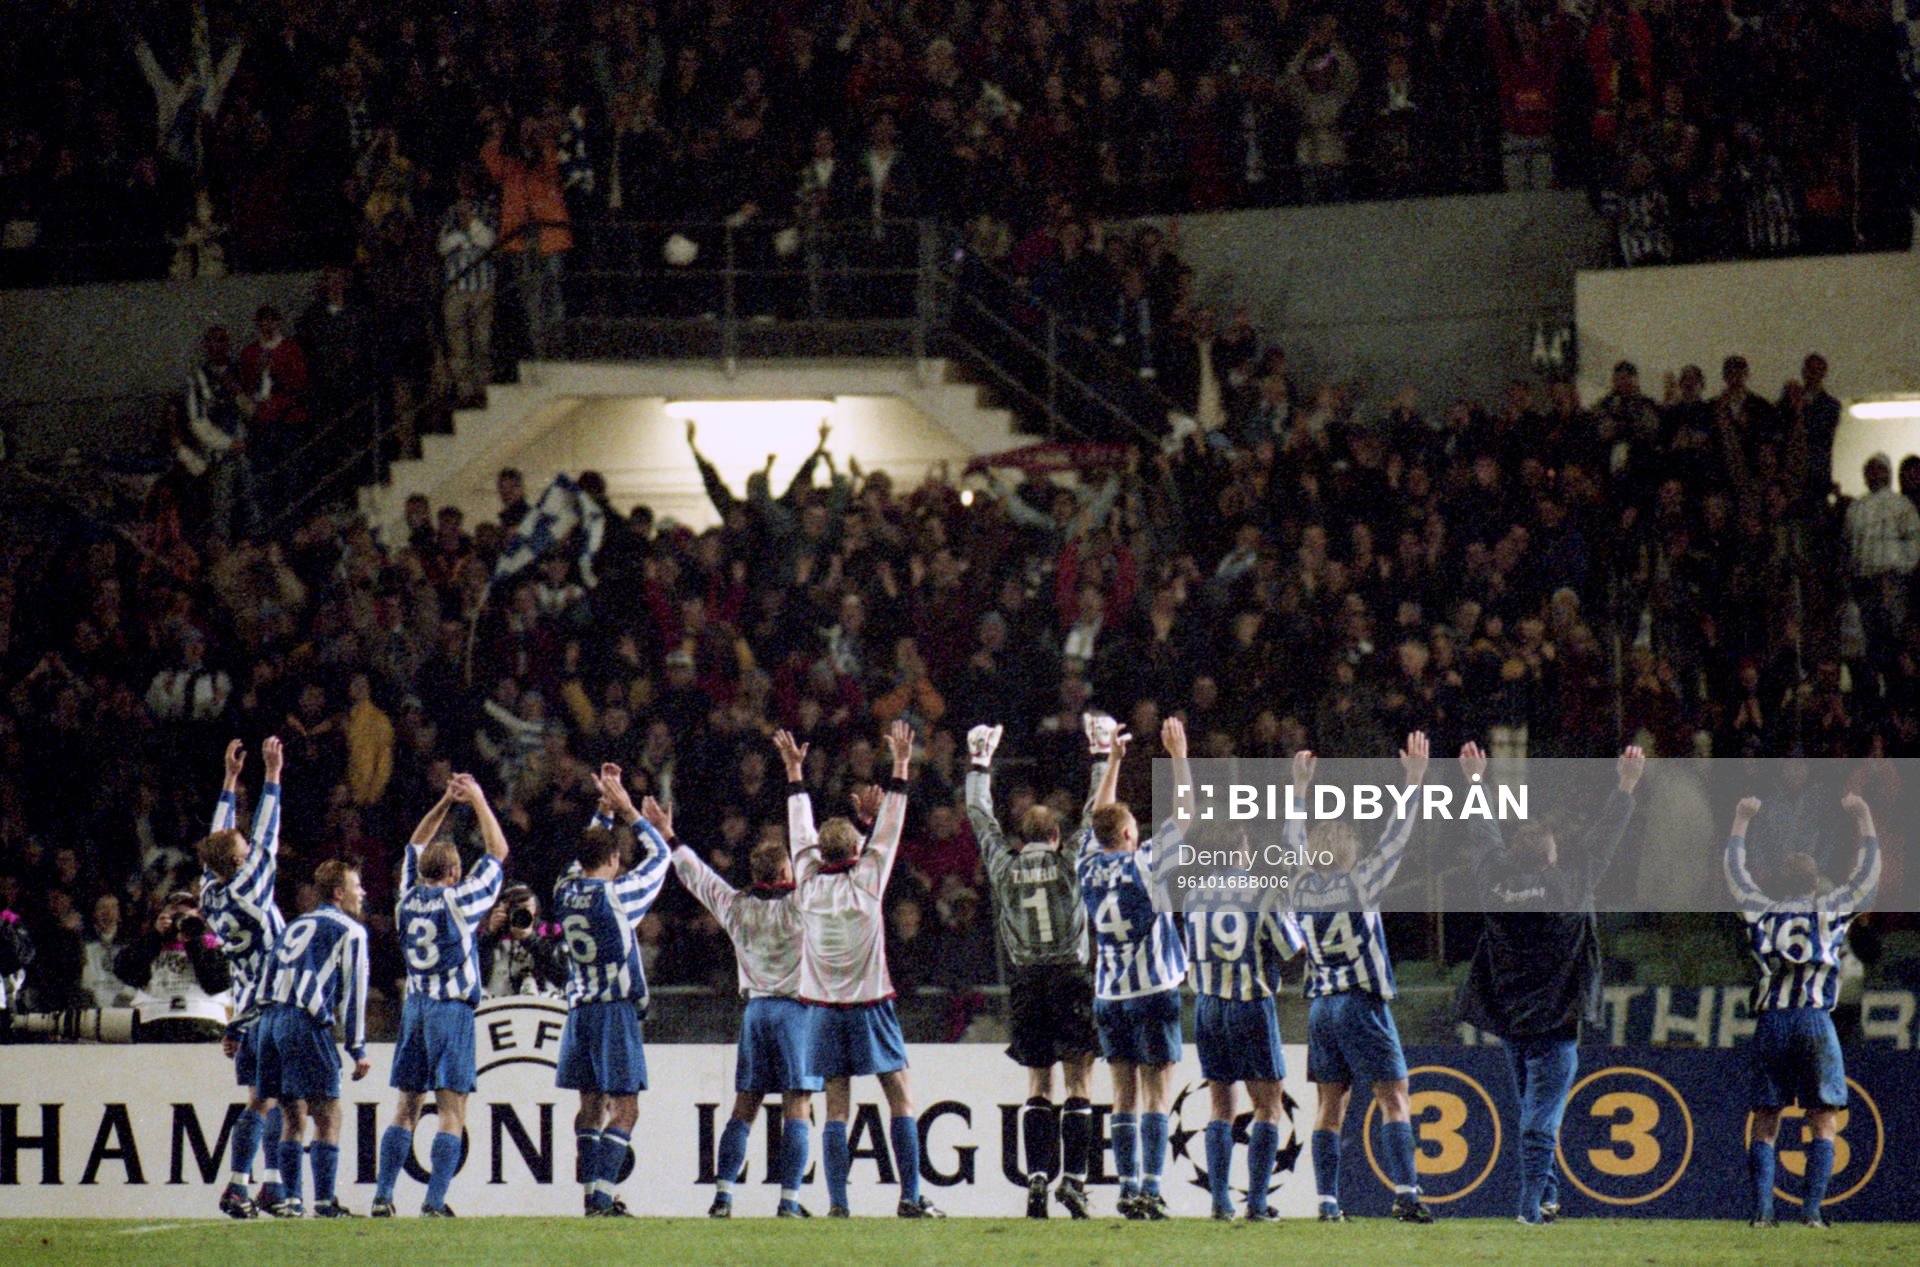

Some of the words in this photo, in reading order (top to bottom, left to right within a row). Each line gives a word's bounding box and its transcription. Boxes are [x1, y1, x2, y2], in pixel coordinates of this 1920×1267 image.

[277, 918, 316, 964] 9
[562, 914, 597, 963] 6
[1022, 887, 1052, 942] 1
[1095, 890, 1133, 942] 4
[1188, 904, 1248, 961] 19
[1300, 908, 1363, 964] 14
[407, 917, 439, 969] 3
[1409, 1090, 1468, 1175] 3
[1588, 1091, 1661, 1176] 3
